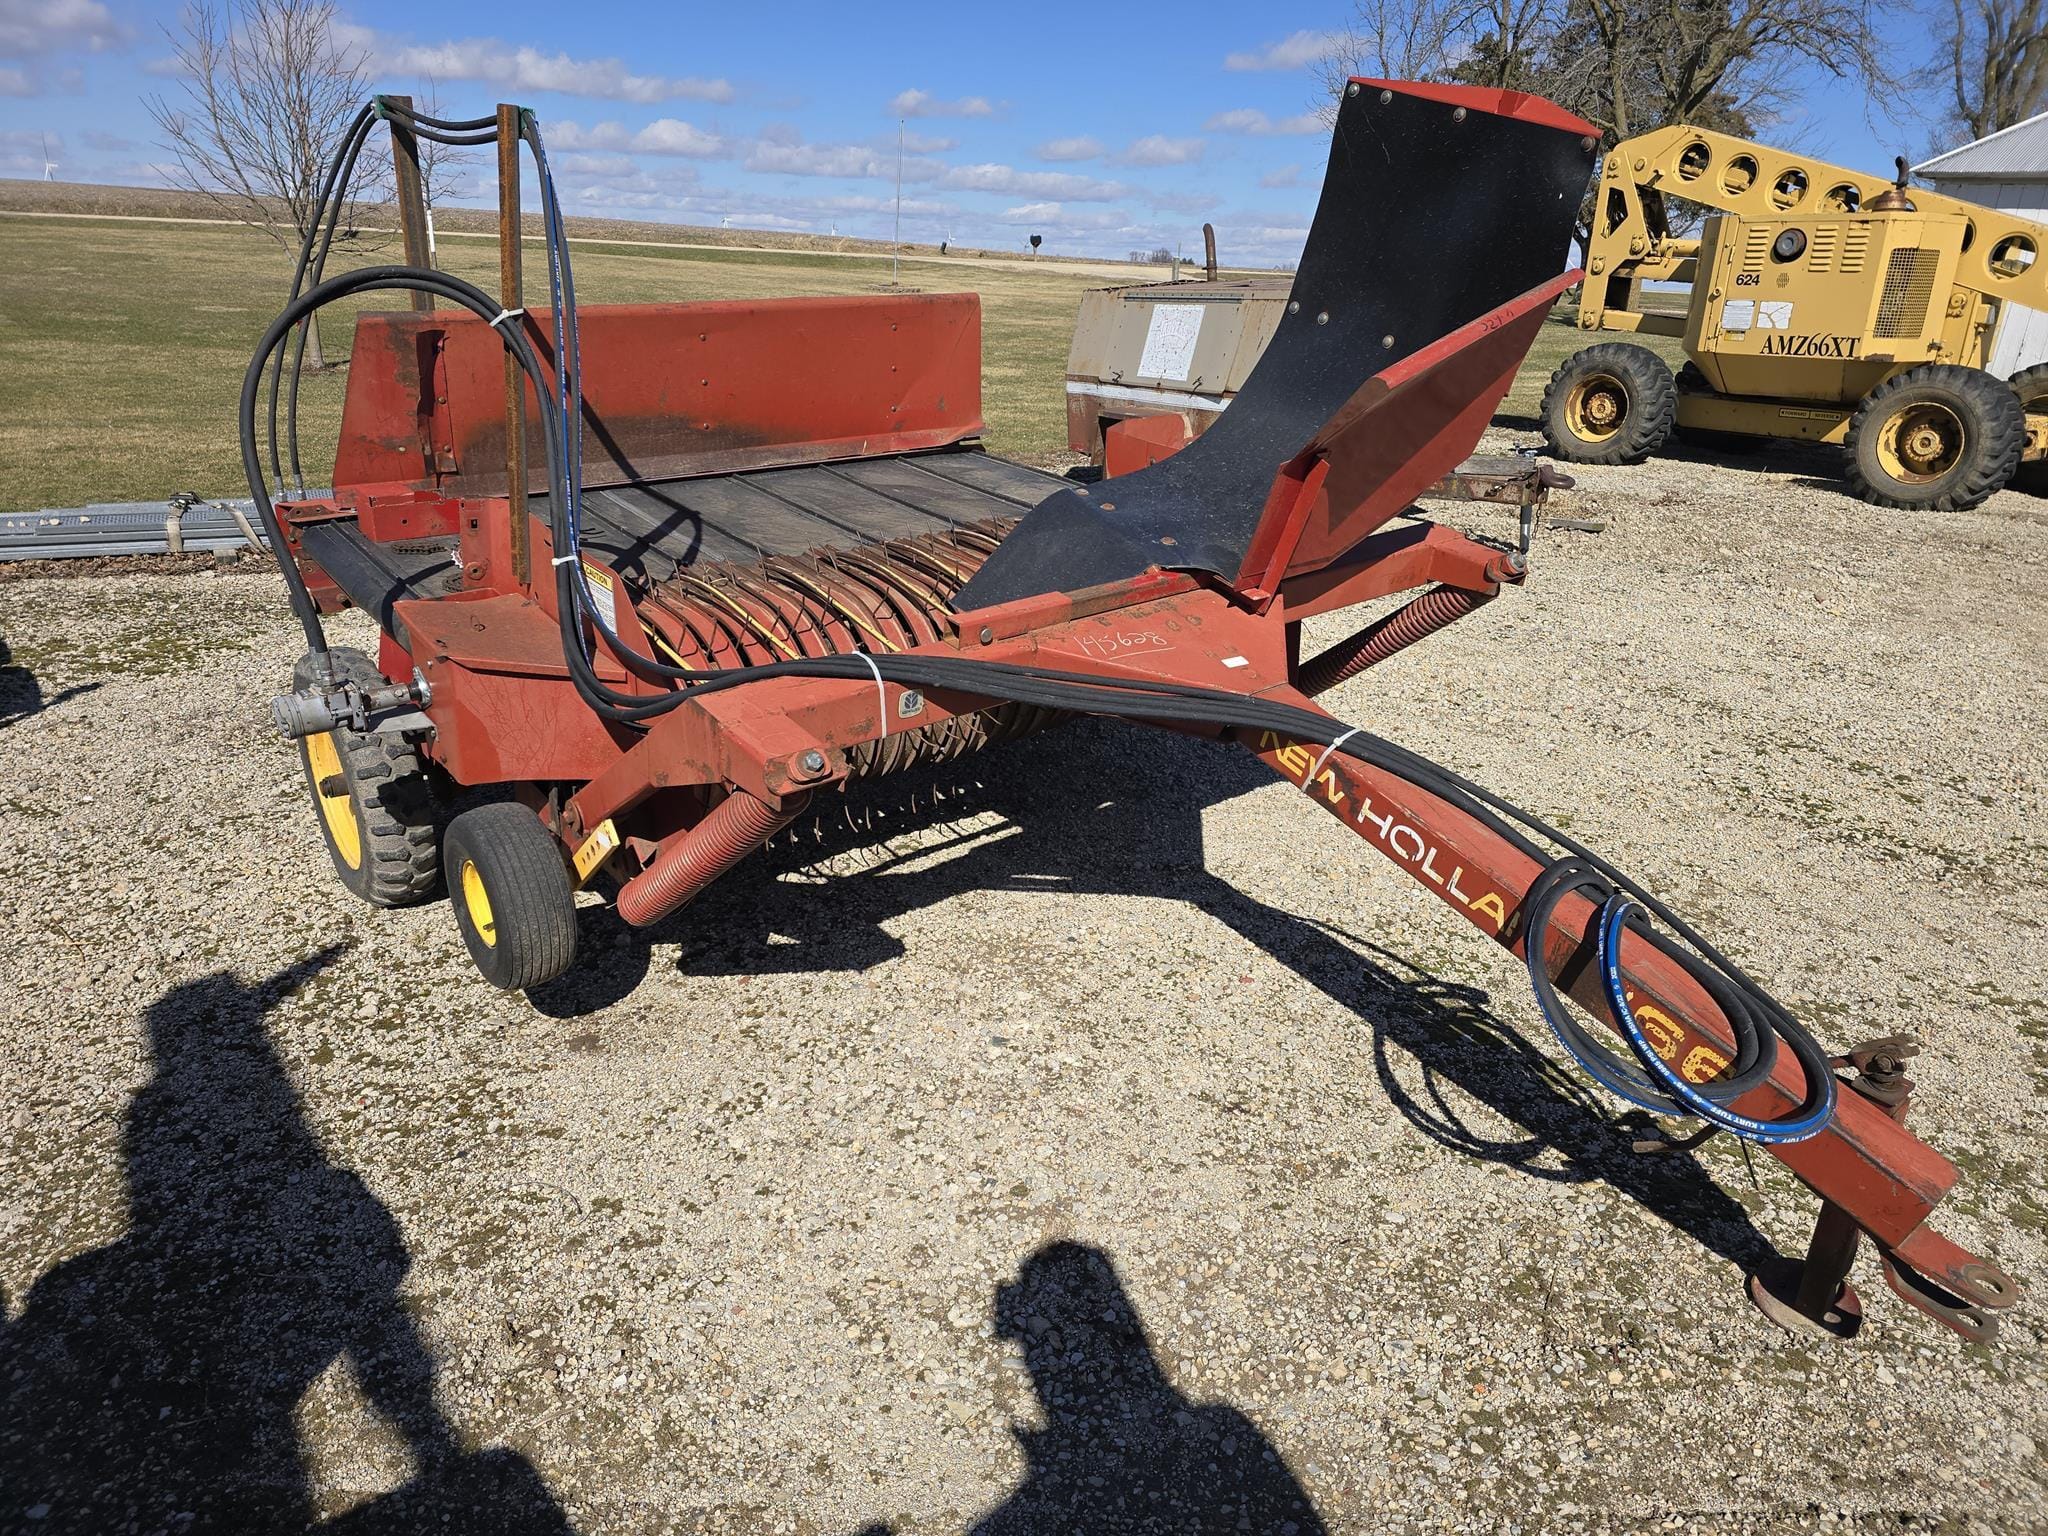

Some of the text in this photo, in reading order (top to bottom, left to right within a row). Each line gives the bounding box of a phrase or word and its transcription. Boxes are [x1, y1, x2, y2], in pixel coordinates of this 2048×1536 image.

[1736, 274, 1760, 286] 624
[1760, 333, 1861, 358] AMZ66XT
[585, 566, 608, 586] CAUTION
[1073, 632, 1168, 656] 145628
[1260, 730, 1344, 804] NEW
[1710, 1106, 1733, 1121] TUFF
[1734, 1114, 1758, 1130] KURT
